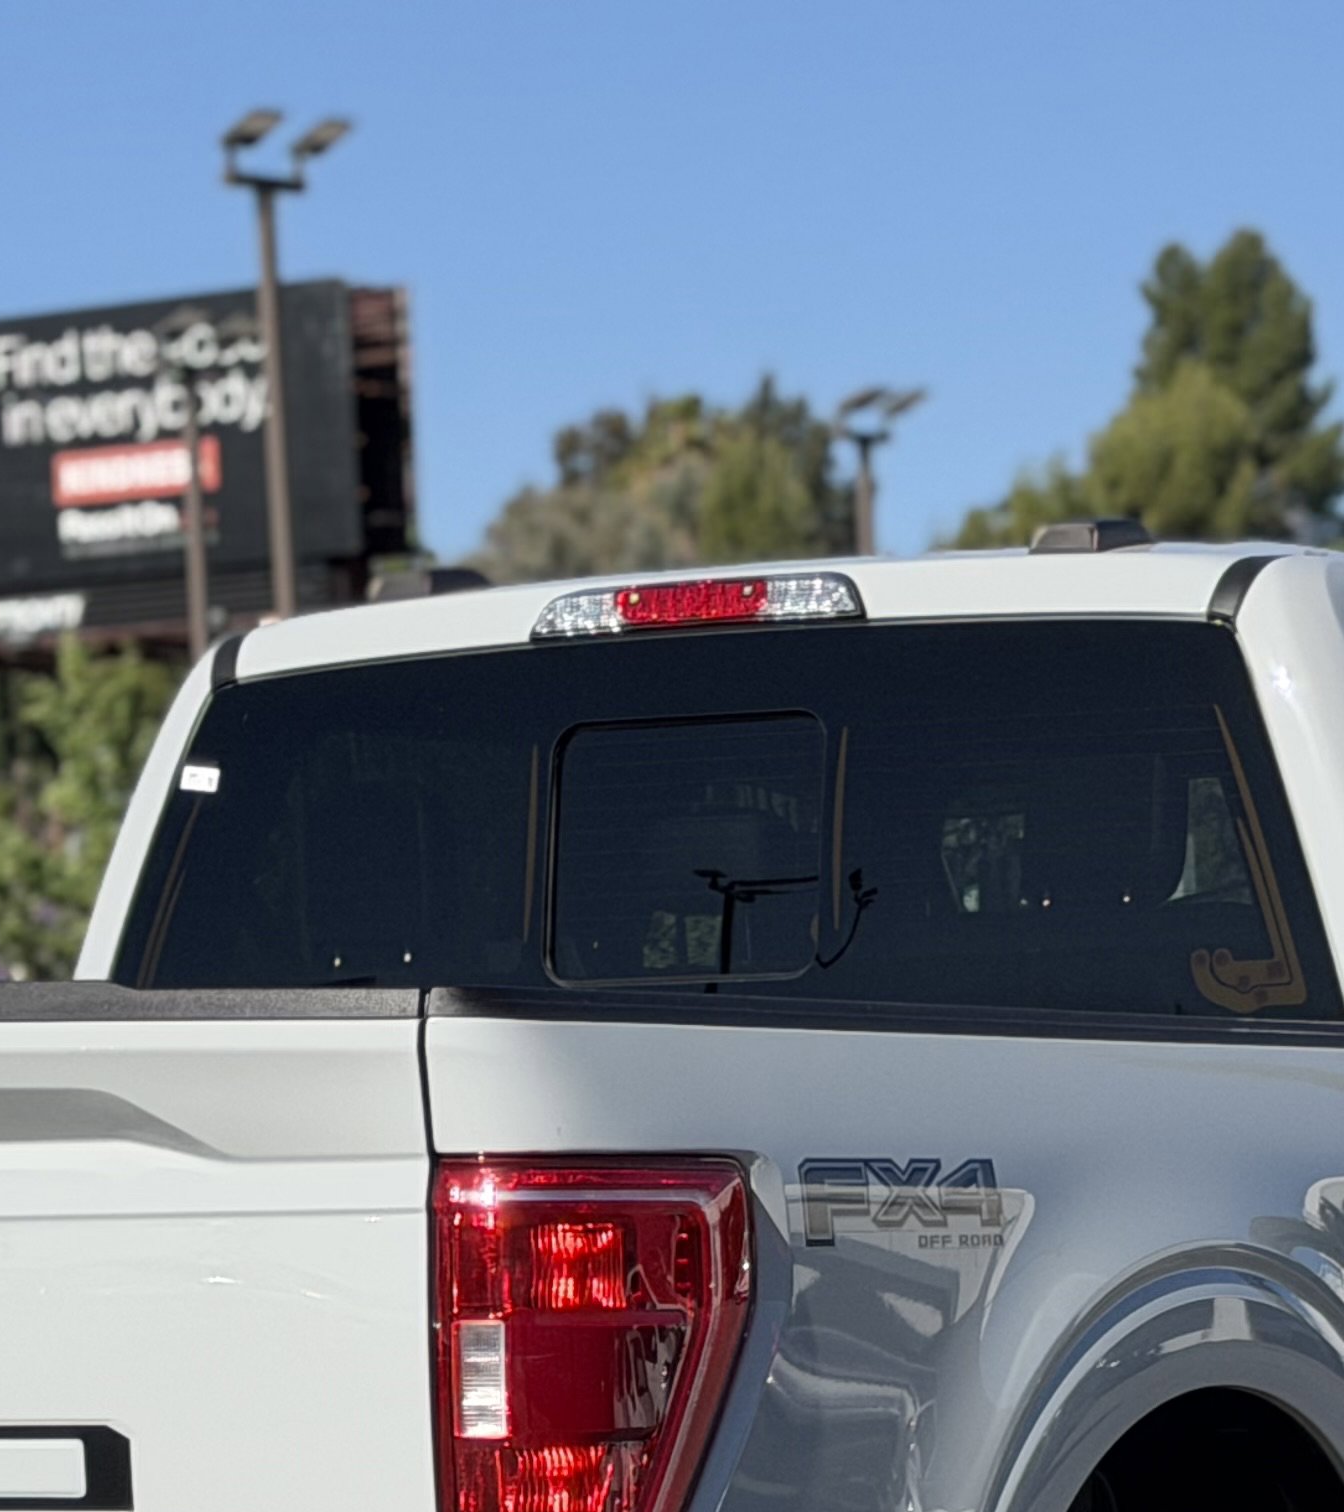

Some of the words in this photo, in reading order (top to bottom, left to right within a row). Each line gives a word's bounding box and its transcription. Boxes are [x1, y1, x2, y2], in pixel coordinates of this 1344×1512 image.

[82, 324, 158, 382] the
[1, 391, 45, 447] in
[798, 1158, 1004, 1247] FX4
[918, 1234, 952, 1248] OFF
[958, 1234, 1004, 1248] ROAD
